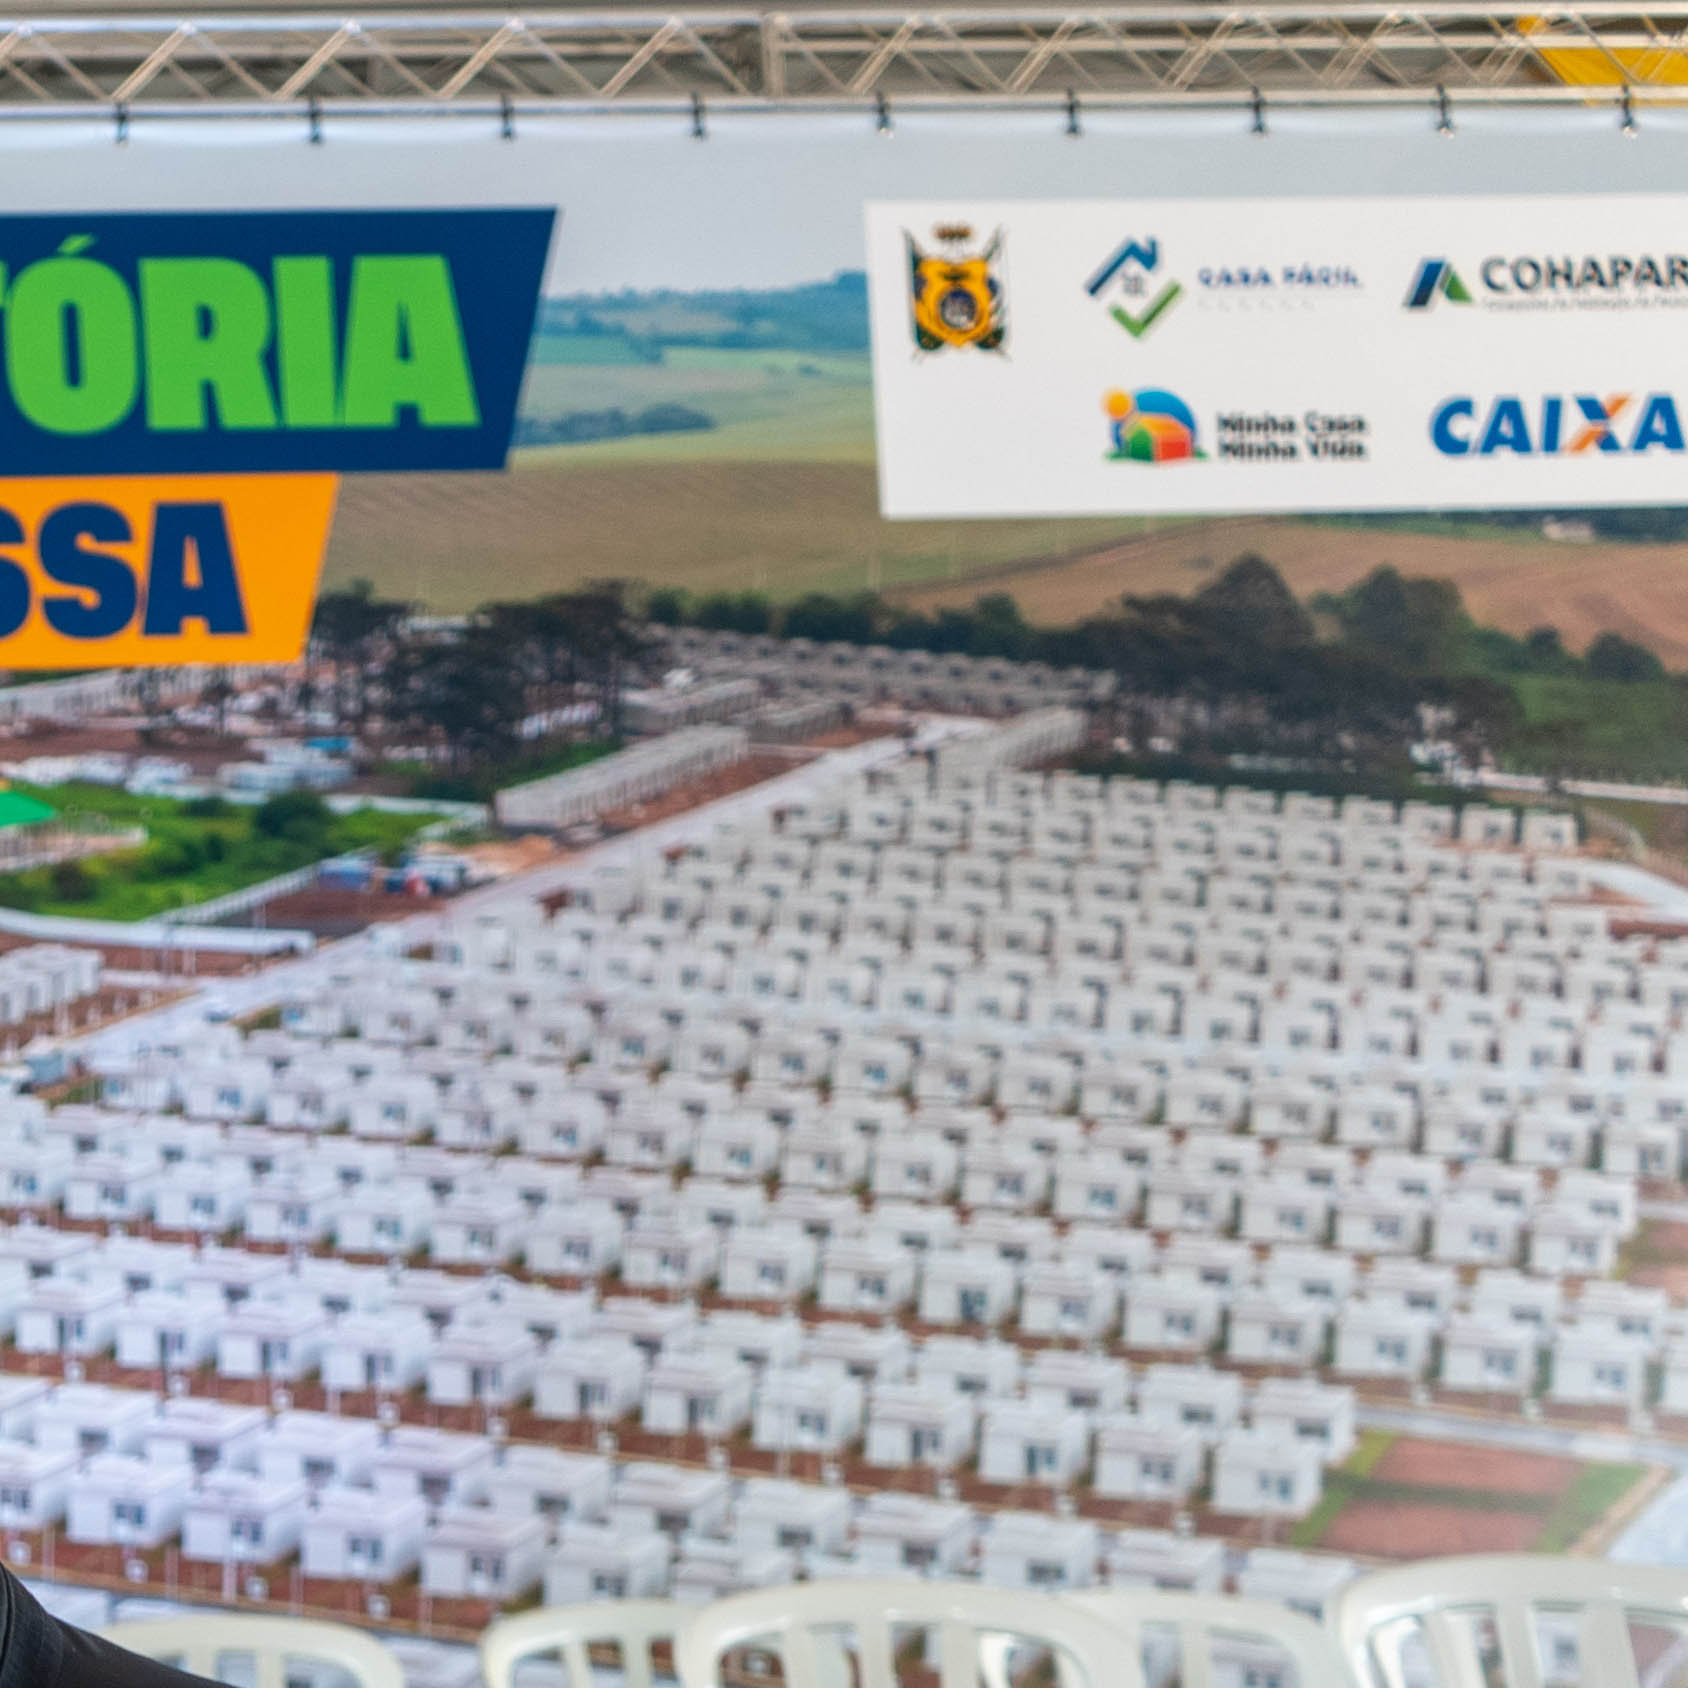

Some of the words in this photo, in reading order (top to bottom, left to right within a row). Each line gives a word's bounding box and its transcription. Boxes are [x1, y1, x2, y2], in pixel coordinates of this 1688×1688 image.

[1197, 266, 1274, 287] CASA
[1480, 253, 1688, 293] COHAPAR
[1216, 410, 1297, 433] Minha
[1304, 410, 1368, 435] Casa
[1428, 392, 1687, 457] CAIXA
[1217, 436, 1299, 459] Minha
[1304, 433, 1368, 459] Vida
